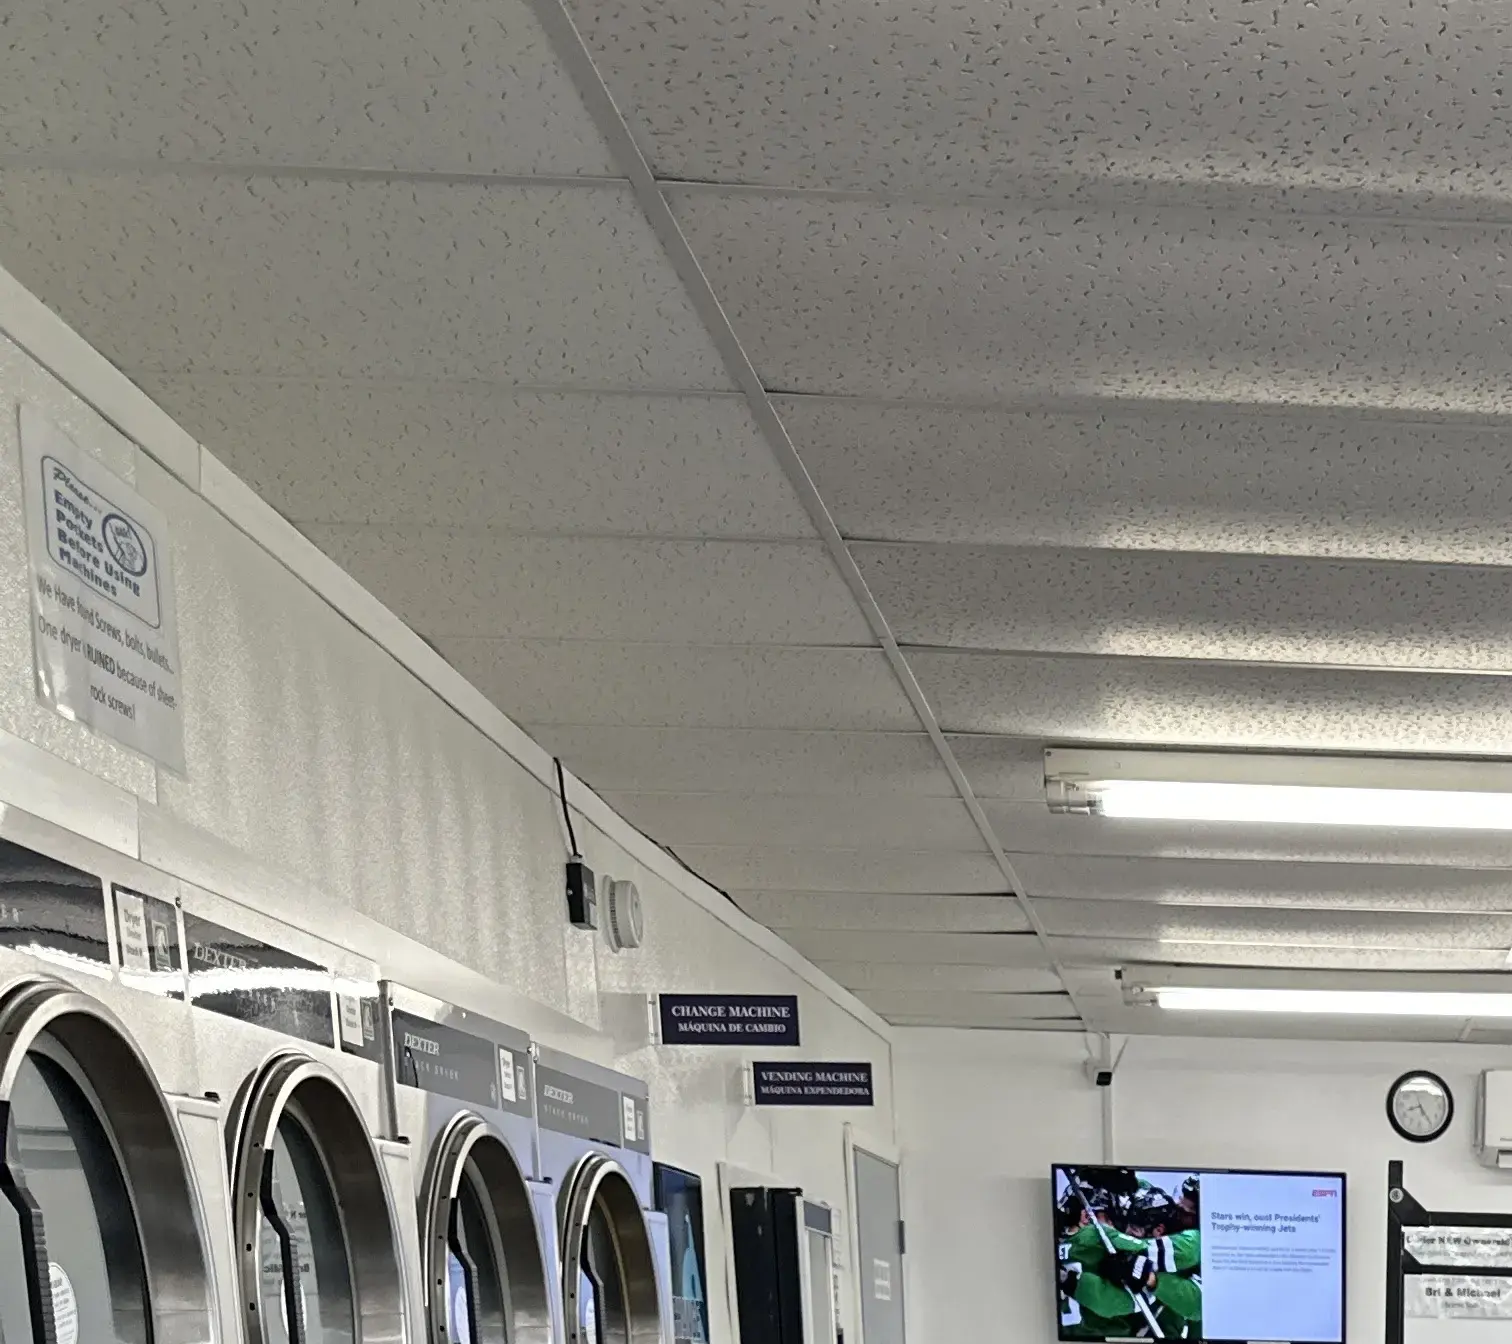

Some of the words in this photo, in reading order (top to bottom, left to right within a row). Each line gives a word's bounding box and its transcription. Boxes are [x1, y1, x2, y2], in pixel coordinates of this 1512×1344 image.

[54, 489, 93, 530] Empty
[56, 508, 104, 553] Pockets
[57, 527, 100, 569] Before
[104, 560, 140, 597] Using
[59, 547, 117, 597] Machines
[37, 574, 52, 598] We
[54, 584, 76, 612] Have
[38, 615, 58, 640] One
[87, 643, 115, 674] RUINED
[116, 660, 147, 693] because
[90, 684, 106, 704] rock
[671, 1005, 726, 1018] CHANGE
[728, 1006, 791, 1018] MACHINE
[678, 1020, 727, 1033] MÁQUINA
[728, 1023, 744, 1032] DE
[745, 1023, 786, 1033] CAMBIO
[404, 1032, 439, 1056] DEXTER
[761, 1071, 813, 1082] VENDING
[815, 1072, 868, 1082] MACHINE
[1211, 1212, 1233, 1221] Stars
[1278, 1224, 1296, 1233] Jets
[1444, 1287, 1453, 1297] &
